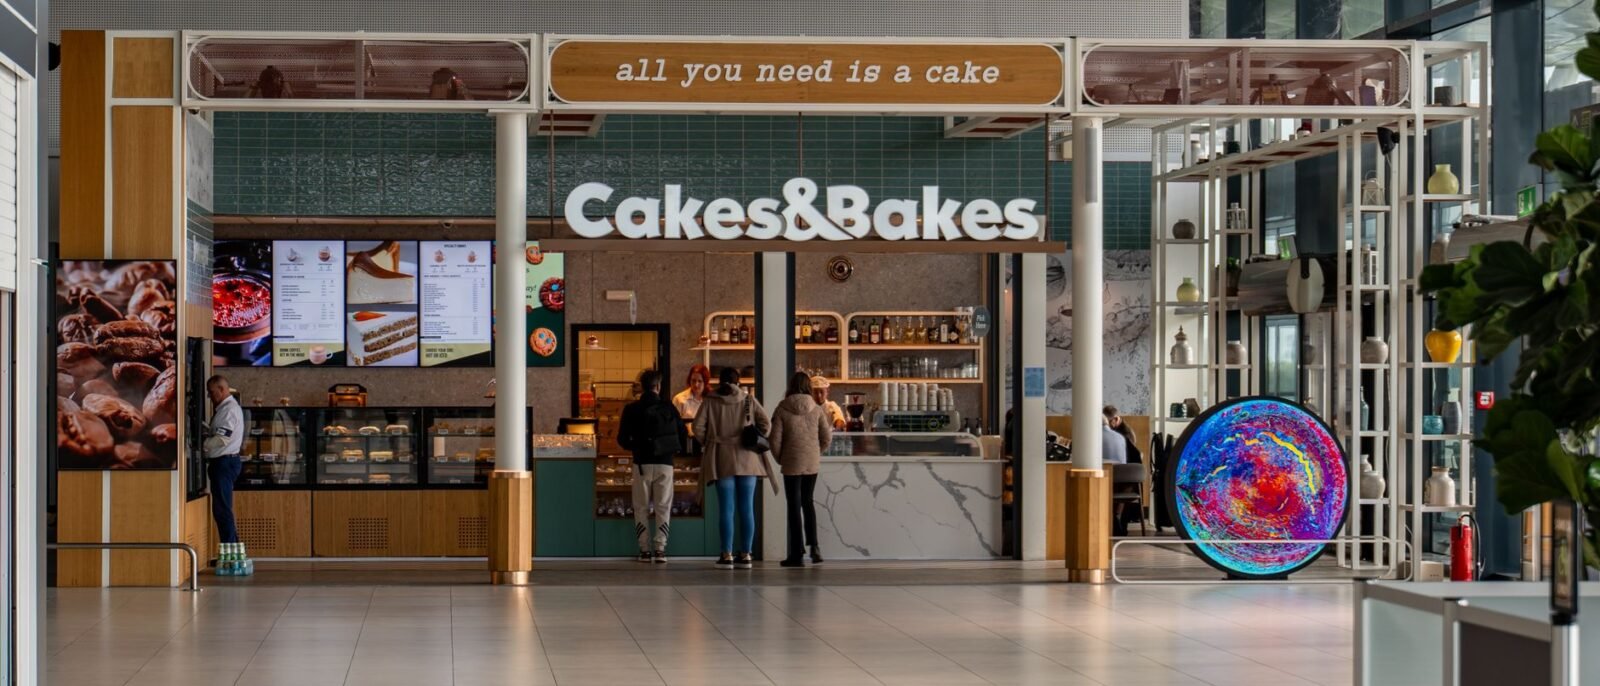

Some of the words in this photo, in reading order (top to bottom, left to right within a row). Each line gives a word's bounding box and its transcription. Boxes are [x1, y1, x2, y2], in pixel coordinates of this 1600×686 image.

[615, 58, 667, 82] all
[681, 62, 742, 88] you
[755, 59, 832, 83] need
[846, 60, 881, 83] is
[893, 64, 912, 84] a
[925, 60, 1000, 84] cake
[564, 177, 1039, 241] Cakes&Bakes
